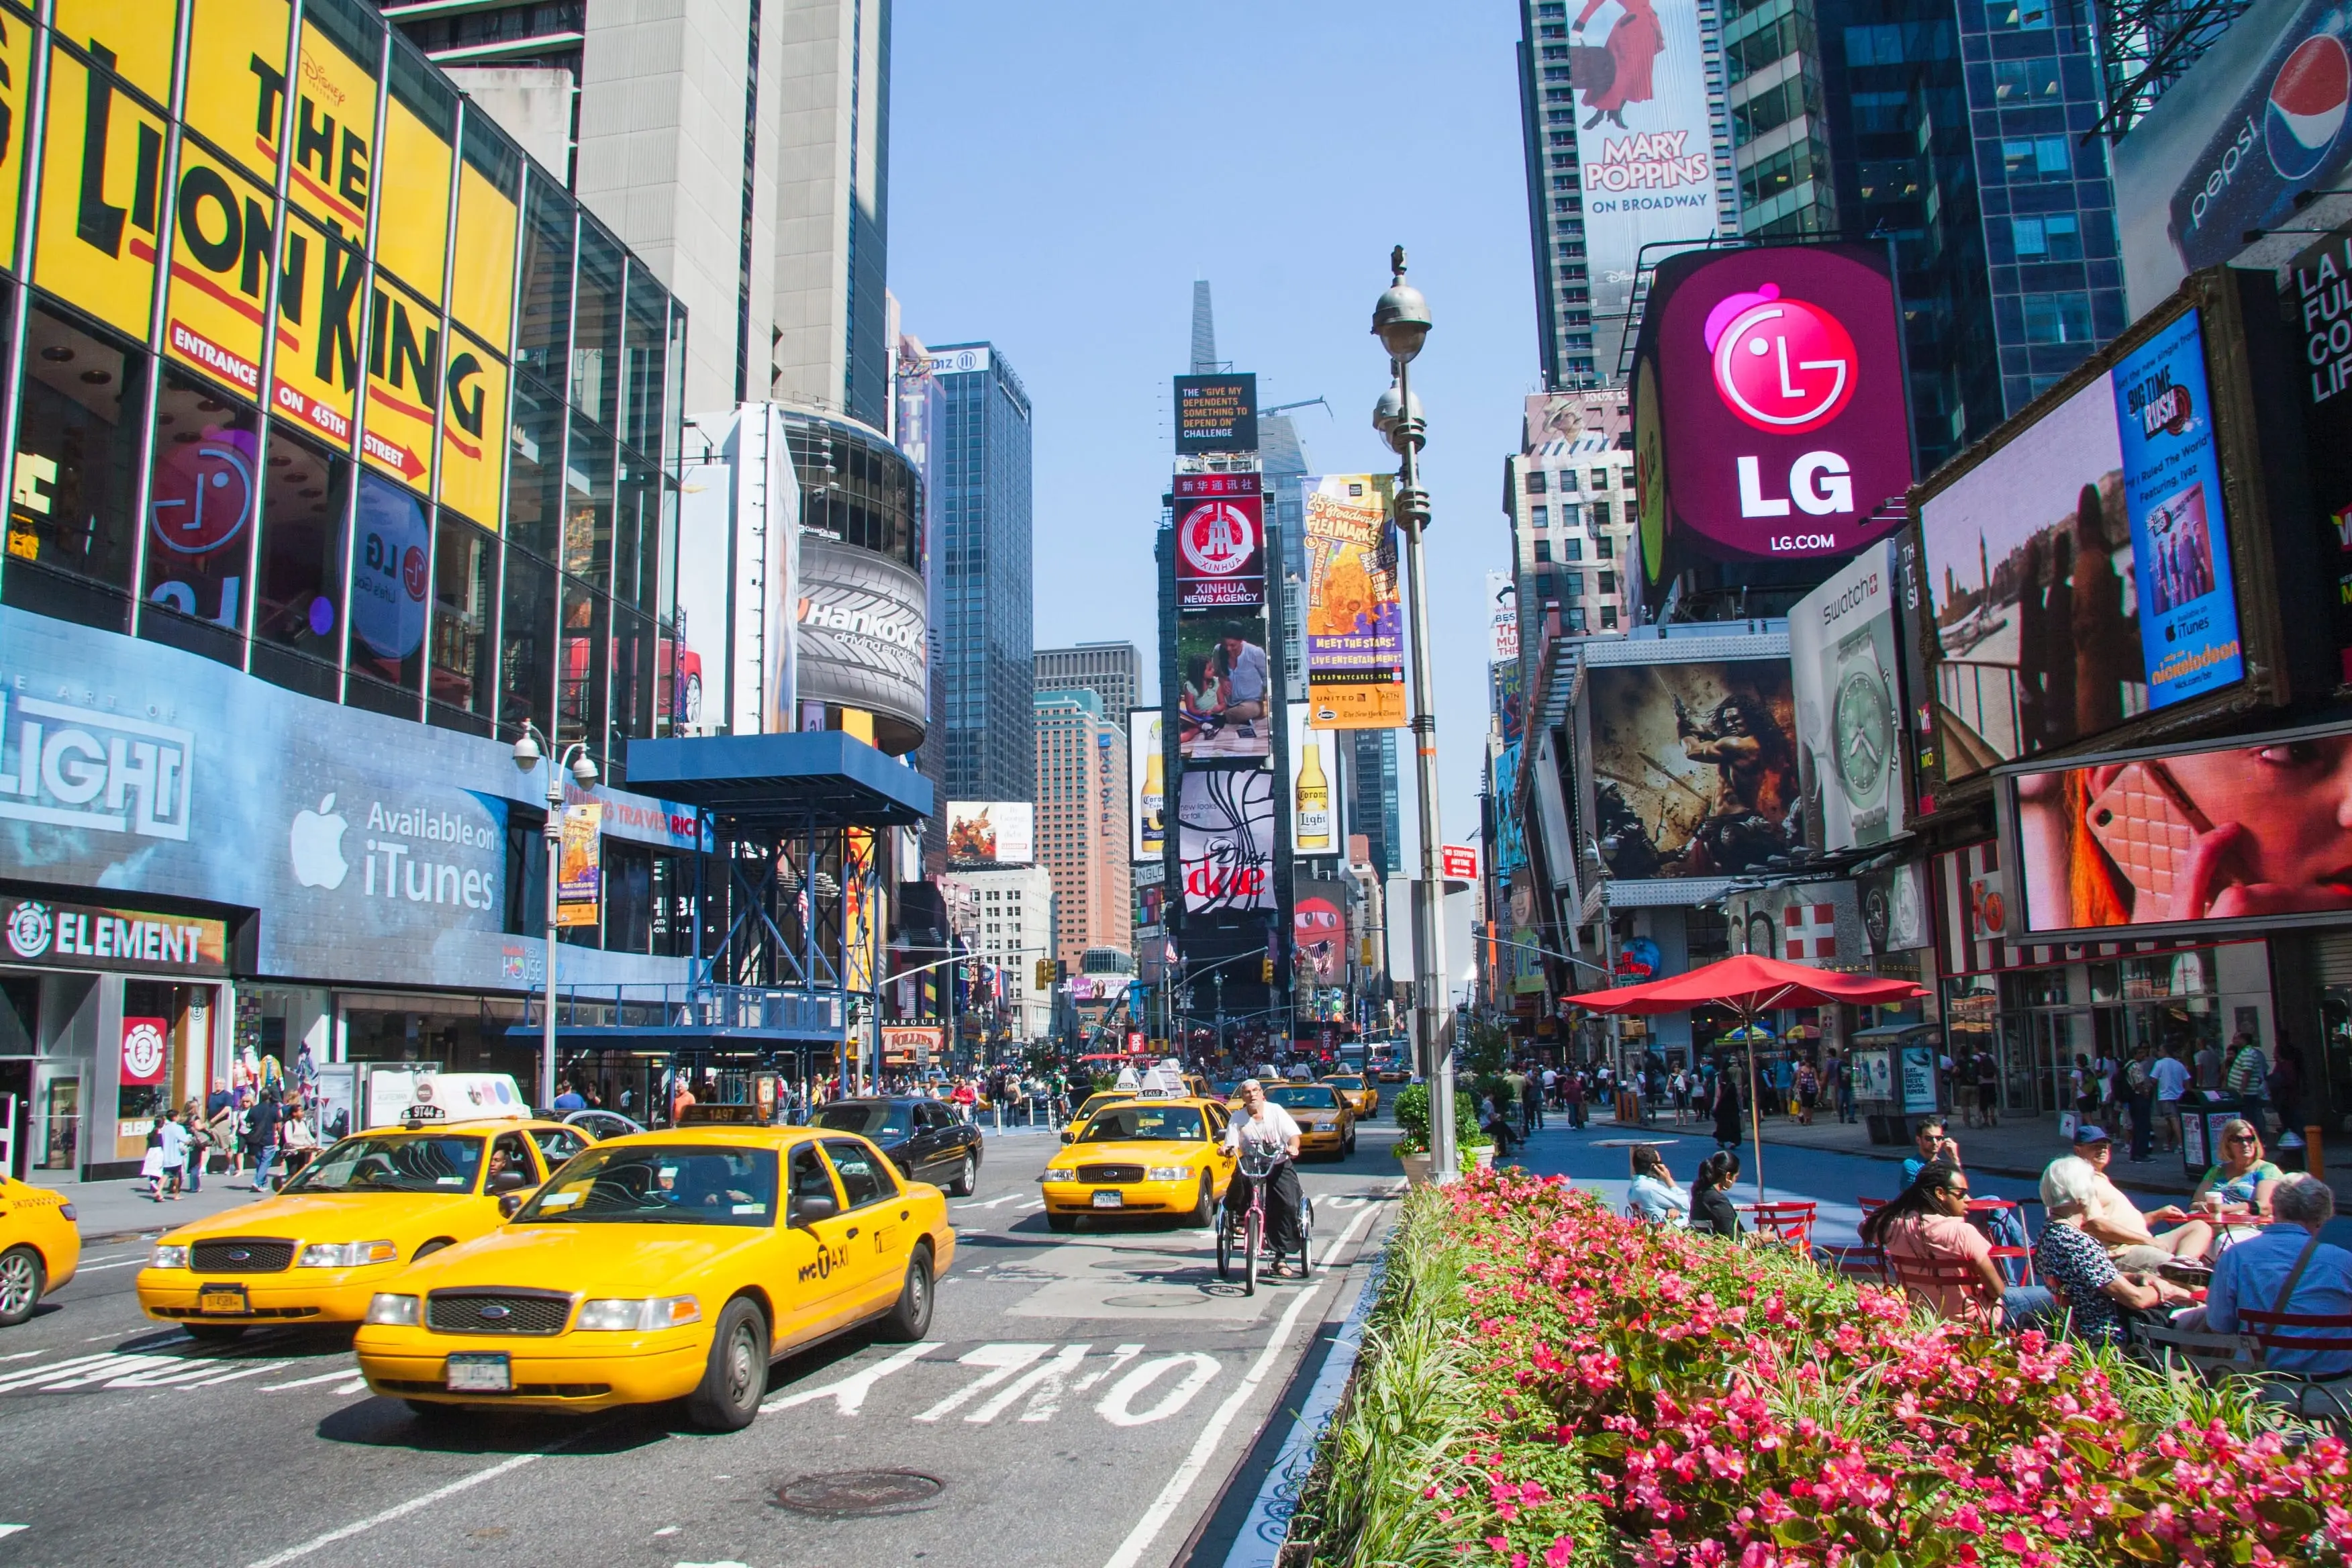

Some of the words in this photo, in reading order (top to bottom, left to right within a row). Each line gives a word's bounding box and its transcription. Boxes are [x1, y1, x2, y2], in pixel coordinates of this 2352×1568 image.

[250, 51, 370, 212] THE
[1603, 130, 1688, 165] MARY
[1585, 153, 1709, 192] POPPINS
[2192, 115, 2257, 230] pepsi
[1592, 201, 1616, 213] ON
[1622, 194, 1707, 211] BROADWAY
[77, 38, 307, 327] LION
[315, 215, 485, 440] KING
[2157, 341, 2179, 362] single
[175, 328, 257, 387] ENTRANCE
[279, 387, 303, 413] ON
[311, 405, 347, 437] 45TH
[363, 434, 404, 469] STREET
[1183, 389, 1199, 397] THE
[1228, 387, 1242, 395] MY
[2128, 383, 2145, 414] BIG
[2145, 364, 2172, 404] TIME
[1183, 397, 1238, 407] DEPENDENTS
[2143, 387, 2177, 434] RUSH
[1183, 408, 1234, 417] SOMETHING
[1236, 407, 1247, 415] TO
[1183, 419, 1216, 428] DEPEND
[1183, 429, 1232, 438] CHALLENGE
[2141, 460, 2163, 482] Ruled
[2165, 453, 2179, 468] The
[1182, 479, 1253, 491] 新华通讯社
[1737, 450, 1854, 518] LG
[1305, 514, 1334, 536] FLEA
[1771, 534, 1834, 550] LG.COM
[1360, 545, 1388, 562] SUNDAY
[1364, 556, 1384, 571] SEPT
[1385, 552, 1396, 562] 25
[1200, 558, 1242, 571] XINHUA
[1372, 569, 1395, 584] TIMES
[1184, 595, 1214, 603] NEWS
[1216, 593, 1258, 603] AGENCY
[1195, 583, 1246, 594] XINHUA
[1824, 577, 1869, 626] swatch
[2177, 616, 2209, 638] iTunes
[834, 632, 881, 651] driving
[883, 643, 918, 666] emotion
[1316, 638, 1342, 649] MEET
[1343, 638, 1362, 648] THE
[1363, 637, 1395, 648] STARS!
[1311, 655, 1330, 665] LIVE
[1332, 653, 1402, 665] ENTERTAINMENT!
[2152, 640, 2239, 687] nickelodeon
[56, 685, 117, 708] ART
[146, 703, 178, 721] OF
[1368, 709, 1382, 719] York
[1297, 789, 1327, 800] Corona
[367, 801, 473, 846] Available
[477, 826, 495, 851] on
[617, 803, 667, 832] TRAVIS
[1300, 813, 1326, 826] Light
[1453, 849, 1475, 859] STOPPING
[364, 838, 494, 912] iTunes
[56, 911, 203, 964] ELEMENT
[881, 1018, 945, 1026] MARQUIS
[1132, 1034, 1140, 1052] tkts
[1323, 1030, 1332, 1048] tkts
[413, 1106, 435, 1118] 9T44
[709, 1108, 735, 1122] 1A97
[797, 1263, 817, 1284] NYC
